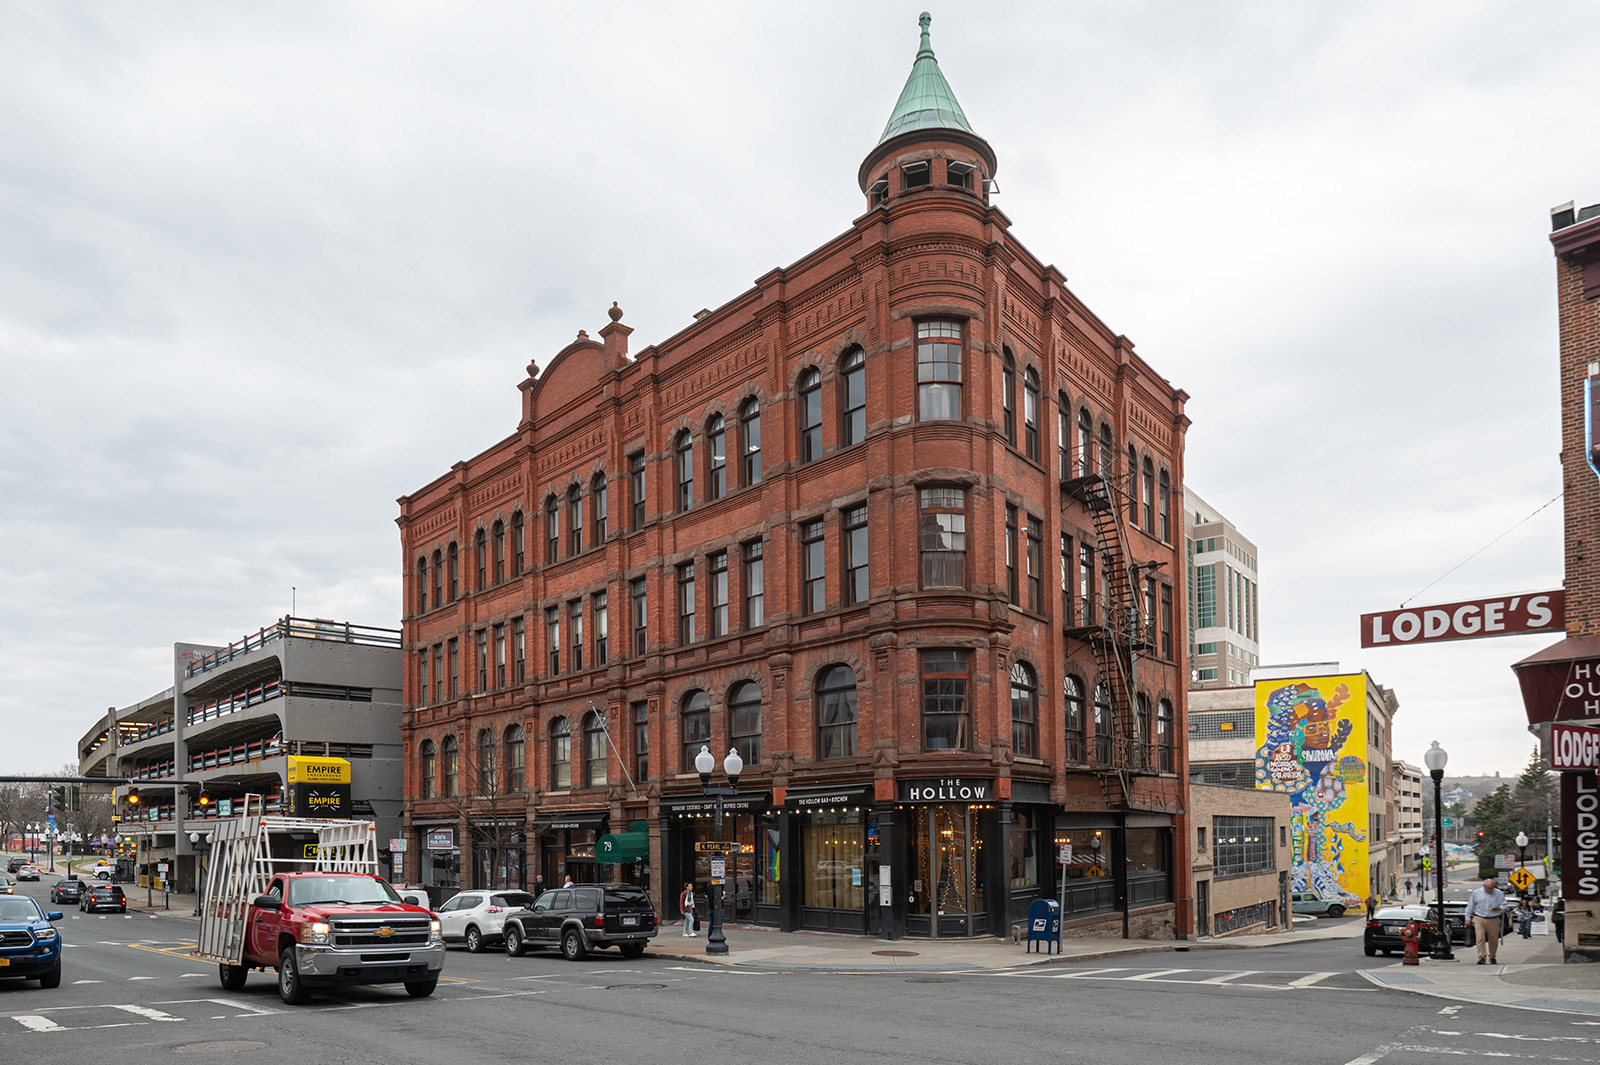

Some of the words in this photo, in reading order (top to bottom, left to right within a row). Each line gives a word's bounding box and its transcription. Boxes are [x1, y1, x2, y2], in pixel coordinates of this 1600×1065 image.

[1373, 596, 1553, 643] LODGE'S
[307, 765, 341, 774] EMPIRE
[910, 787, 985, 800] HOLLOW
[308, 797, 341, 805] EMPIRE
[604, 841, 612, 852] 79
